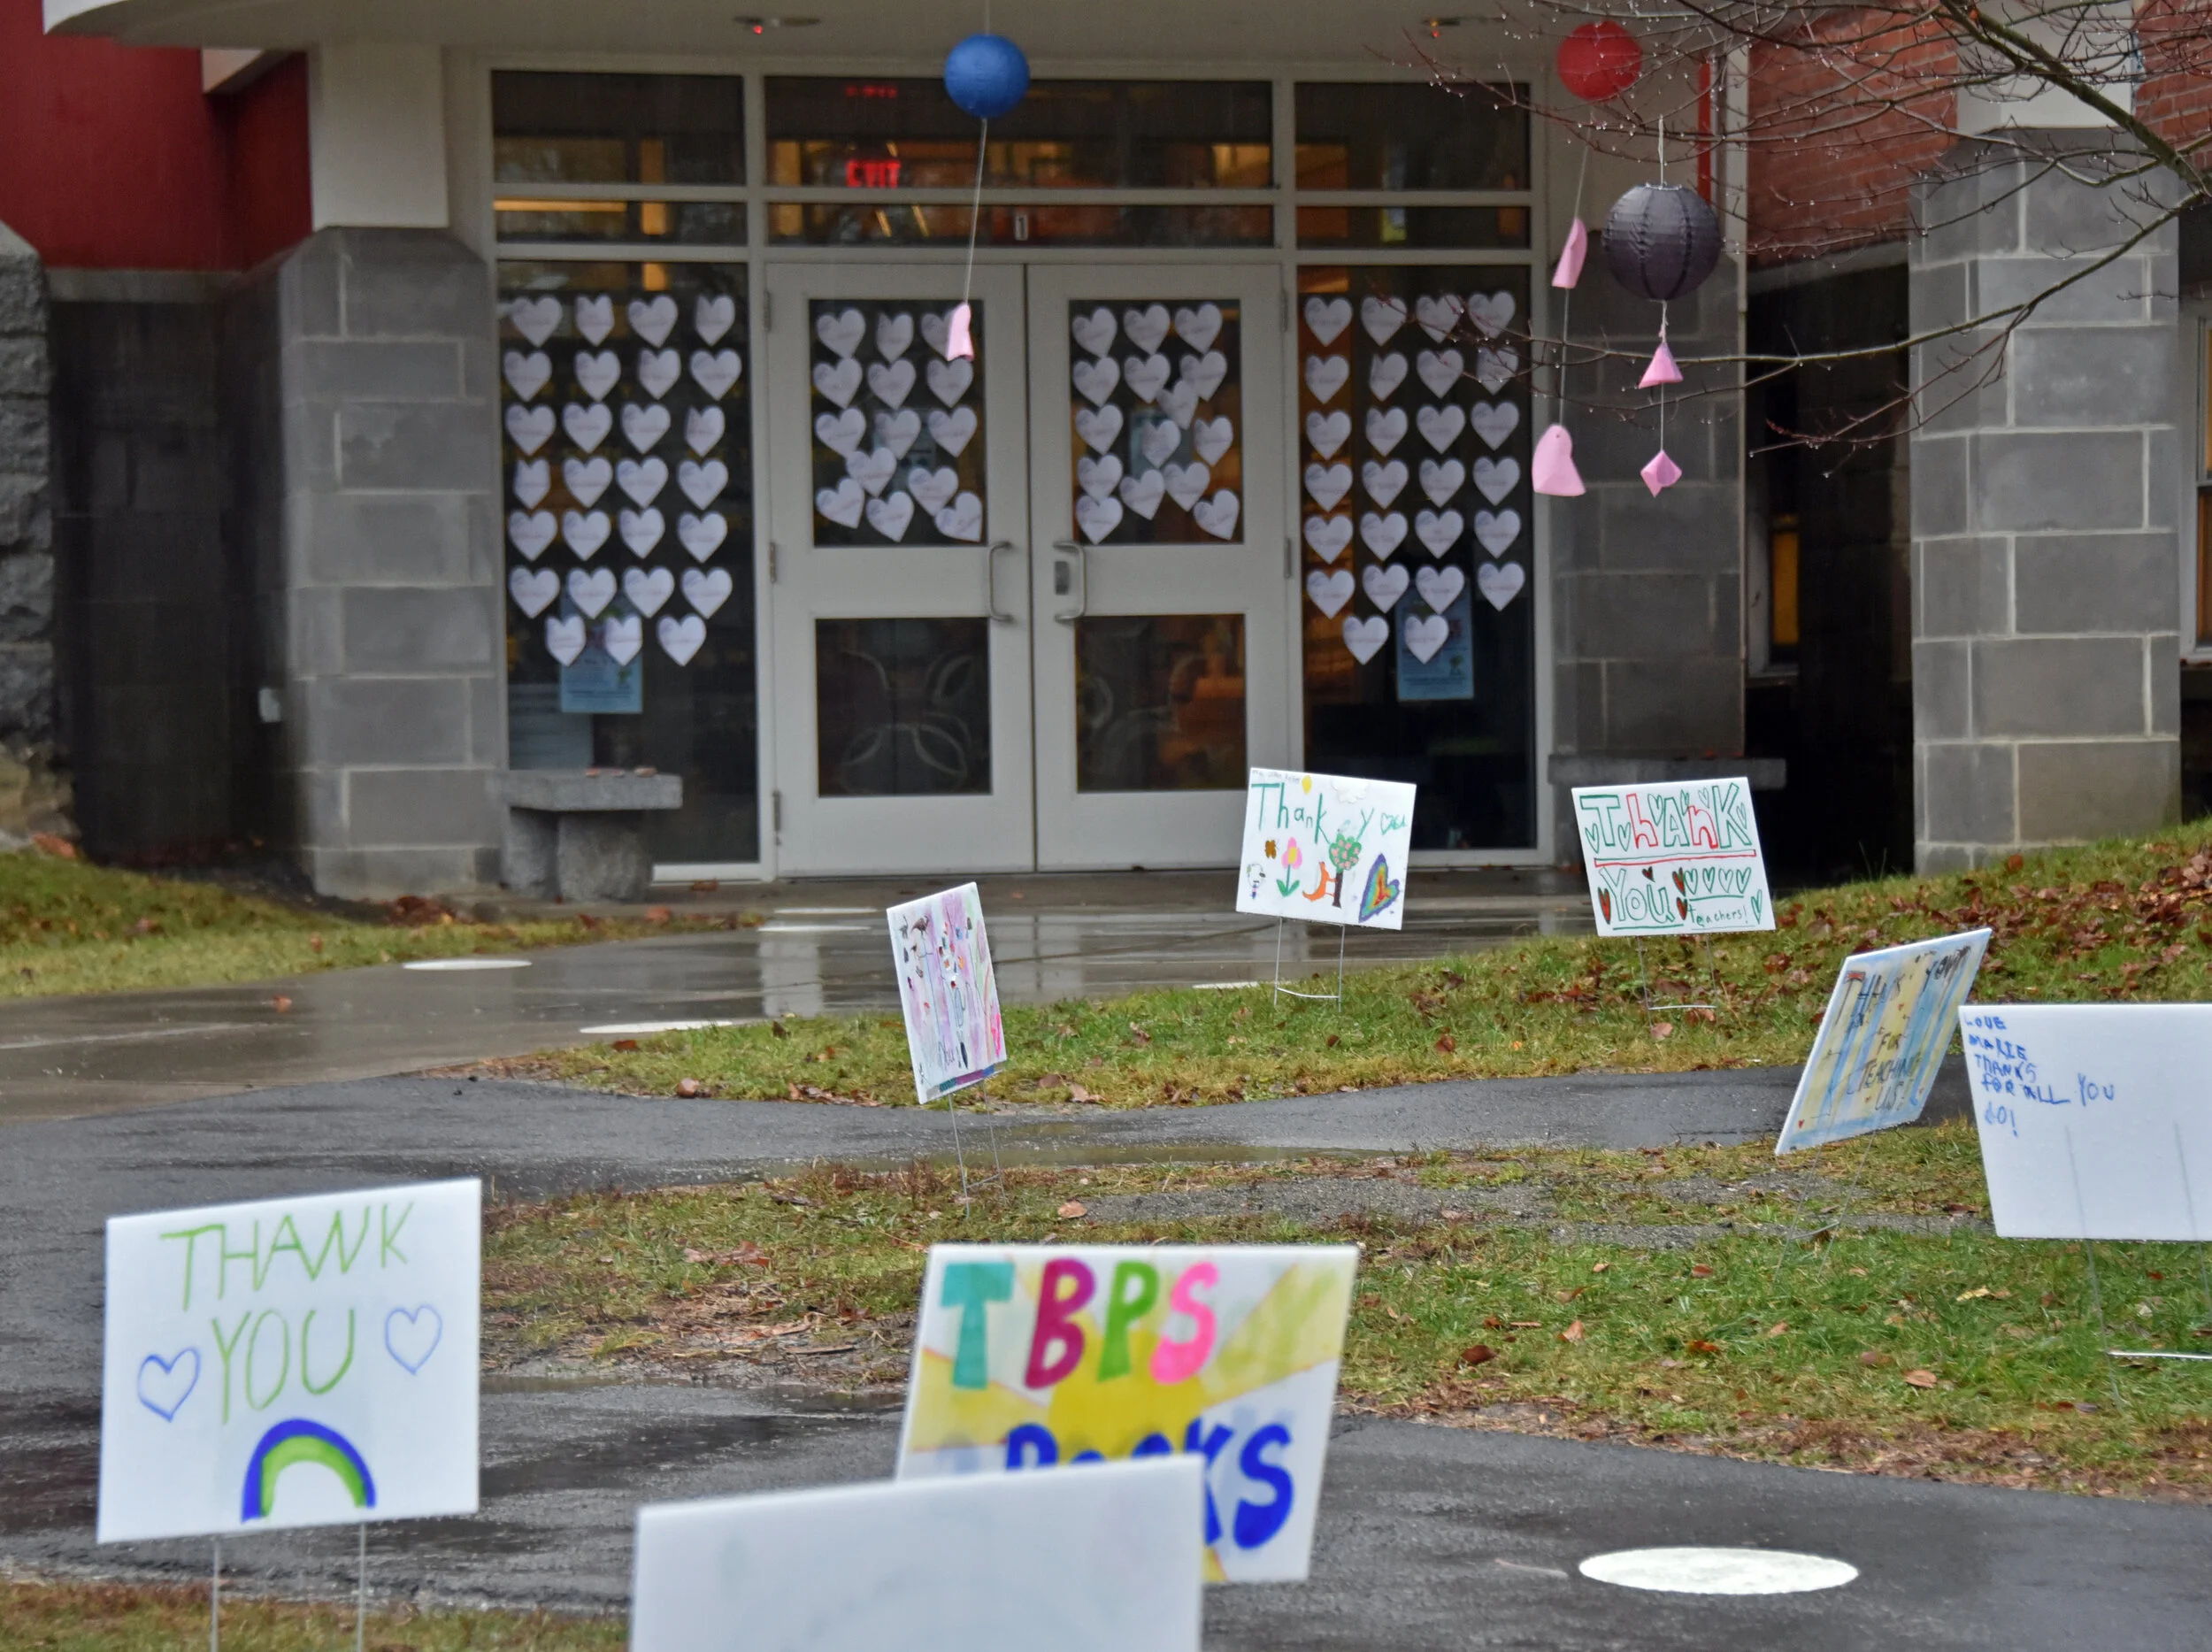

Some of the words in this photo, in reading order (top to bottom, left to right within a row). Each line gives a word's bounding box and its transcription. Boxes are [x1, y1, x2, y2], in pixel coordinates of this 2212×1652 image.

[1251, 782, 1331, 844] Thank
[1974, 1054, 2037, 1084] THANKS
[2078, 1072, 2115, 1107] YOU
[159, 1202, 414, 1312] THANK
[211, 1308, 355, 1425] YOU
[941, 1257, 1219, 1390] TBPS
